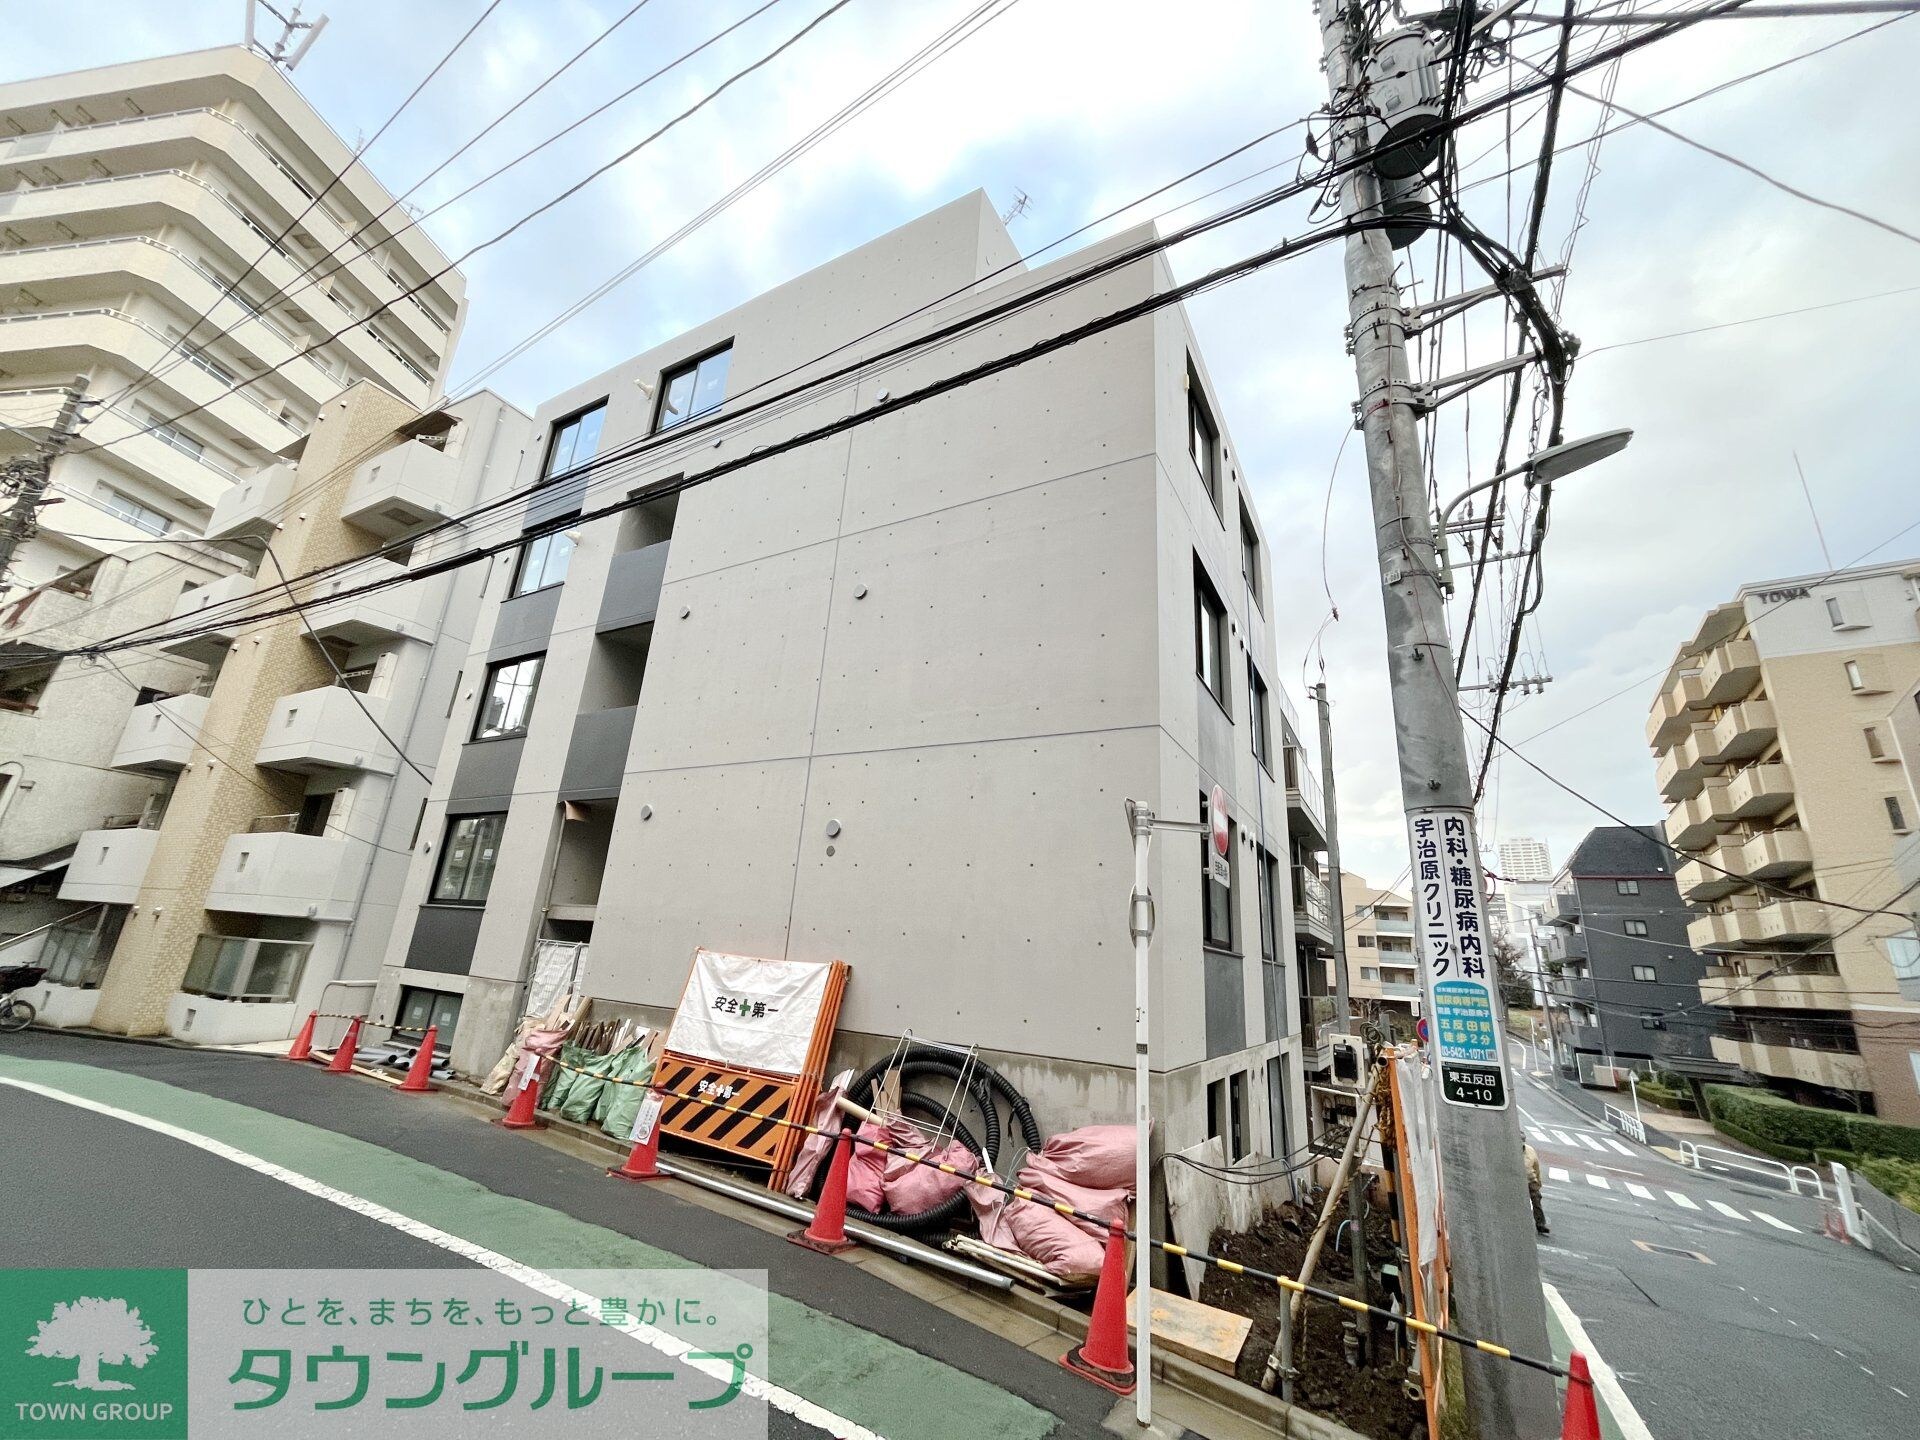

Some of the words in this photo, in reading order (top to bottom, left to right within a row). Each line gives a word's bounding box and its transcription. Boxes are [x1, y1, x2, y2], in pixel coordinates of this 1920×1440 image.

[1758, 587, 1811, 604] TOWA
[1414, 818, 1450, 977] 宇治原クリニック
[1444, 816, 1485, 979] 内科・糖尿病内科
[1440, 1019, 1491, 1032] 五反田駅
[1449, 1071, 1496, 1087] 東五反田
[1456, 1087, 1492, 1101] 4-10
